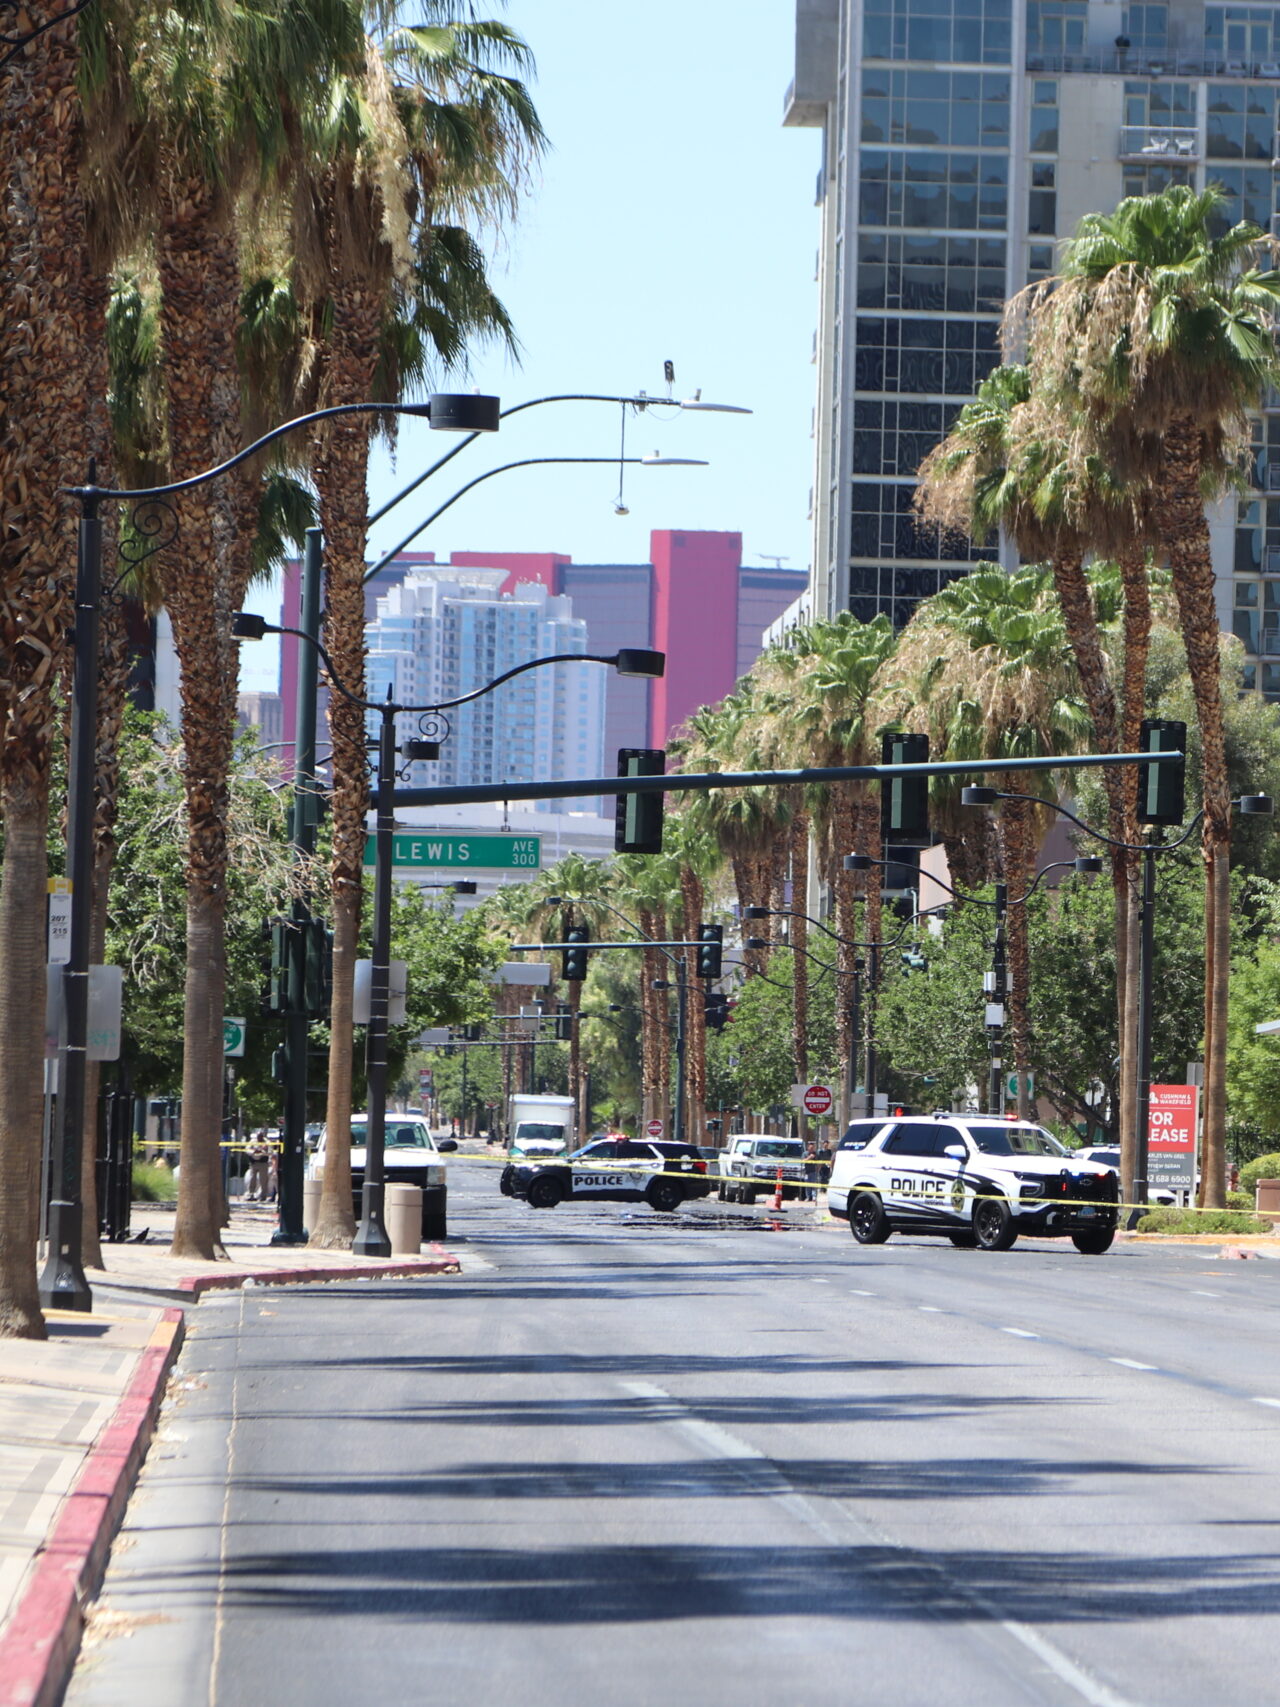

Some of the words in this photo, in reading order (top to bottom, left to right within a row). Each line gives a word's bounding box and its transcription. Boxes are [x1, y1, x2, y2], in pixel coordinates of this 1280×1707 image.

[395, 842, 470, 861] LEWIS
[512, 841, 534, 852] AVE
[512, 853, 536, 865] 300
[1148, 1128, 1189, 1143] EASE
[574, 1175, 623, 1186] POLICE
[1171, 1175, 1191, 1183] 6900
[890, 1178, 946, 1199] POLICE
